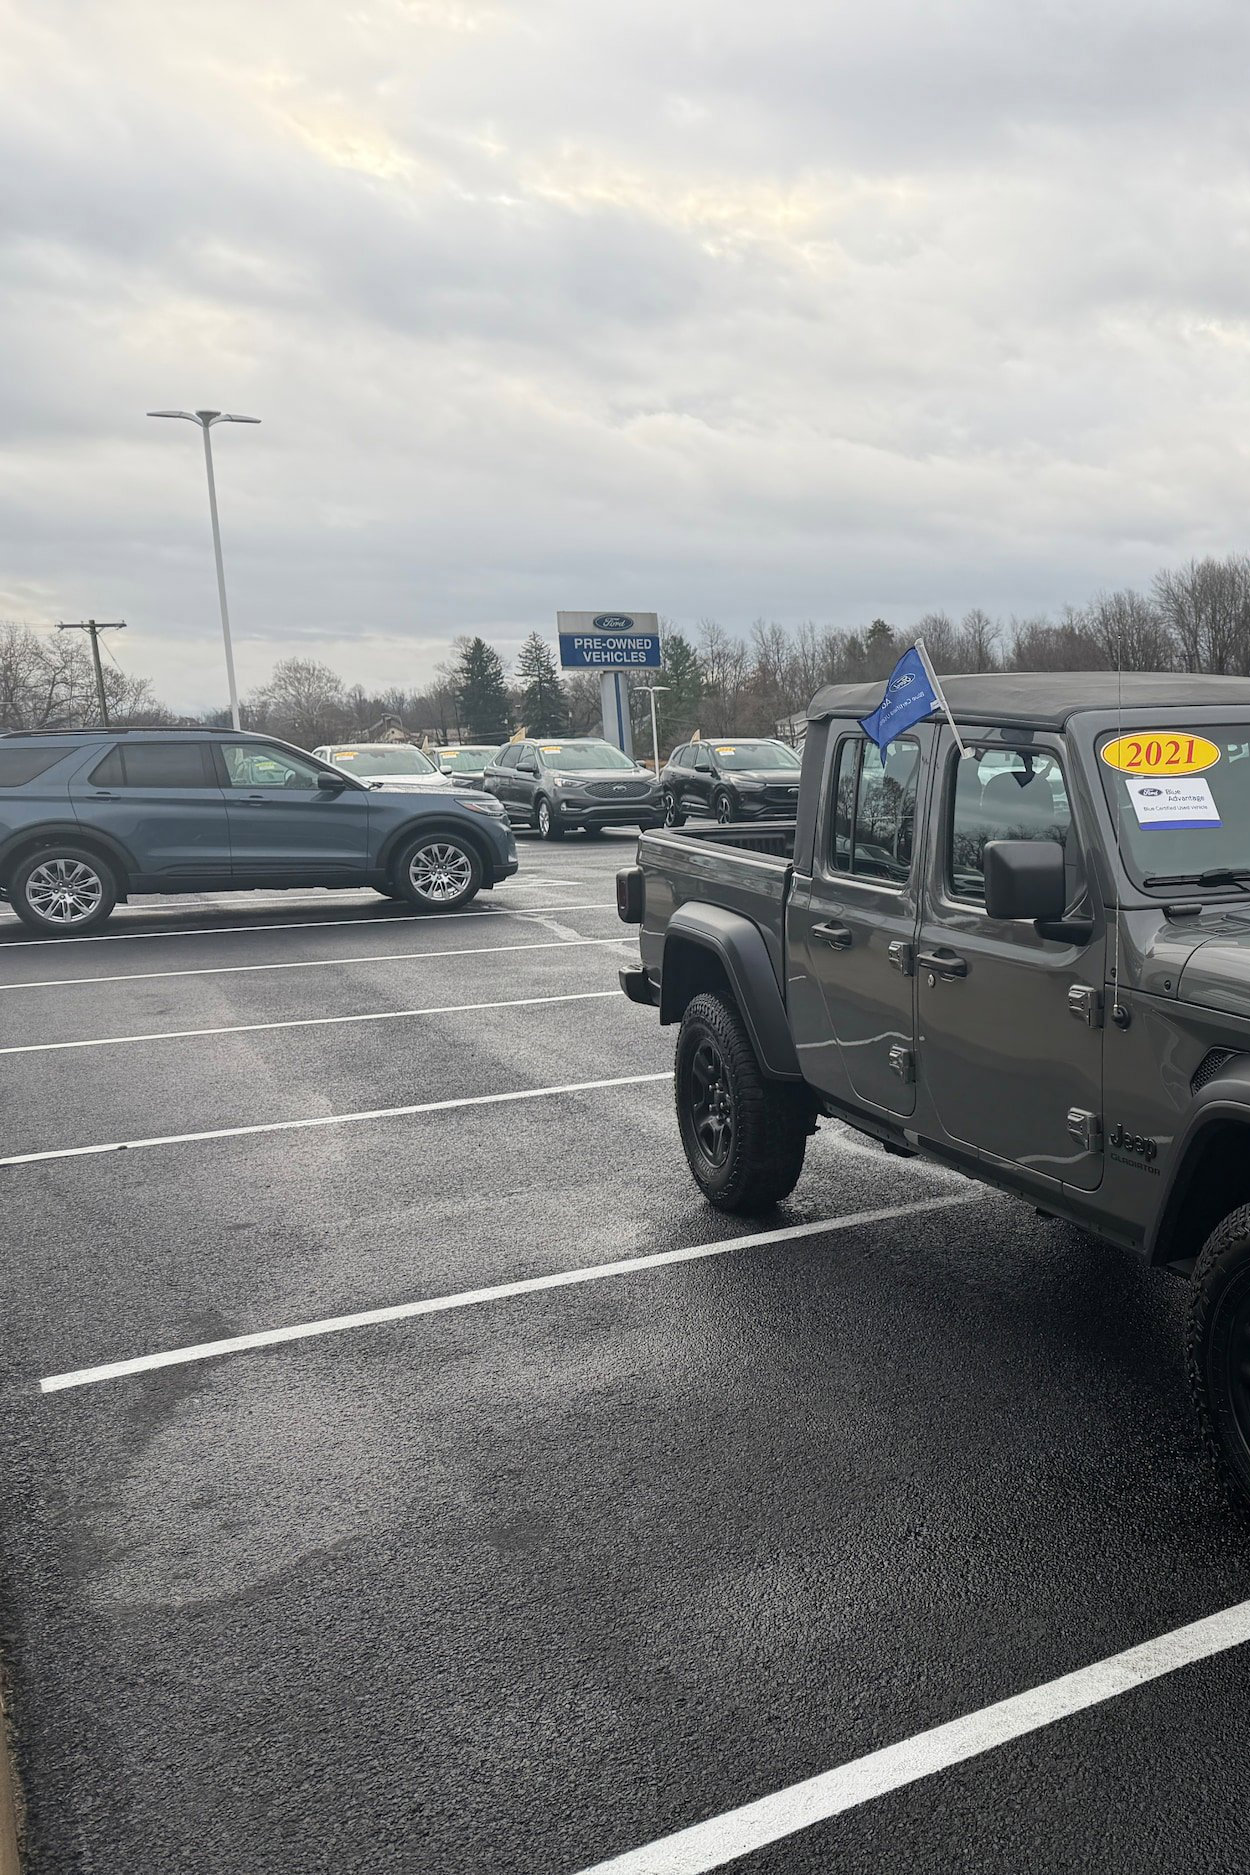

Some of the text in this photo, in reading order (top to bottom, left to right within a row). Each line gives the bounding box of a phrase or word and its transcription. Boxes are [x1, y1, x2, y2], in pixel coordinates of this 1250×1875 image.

[602, 617, 626, 628] Ford
[574, 637, 652, 650] PRE-OWNED
[583, 651, 647, 663] VEHICLES
[1126, 739, 1197, 768] 2021
[1165, 788, 1182, 796] Blue
[1168, 794, 1205, 803] Advantage
[1109, 1123, 1158, 1162] Jeep
[1111, 1152, 1161, 1176] GLADIATOR
